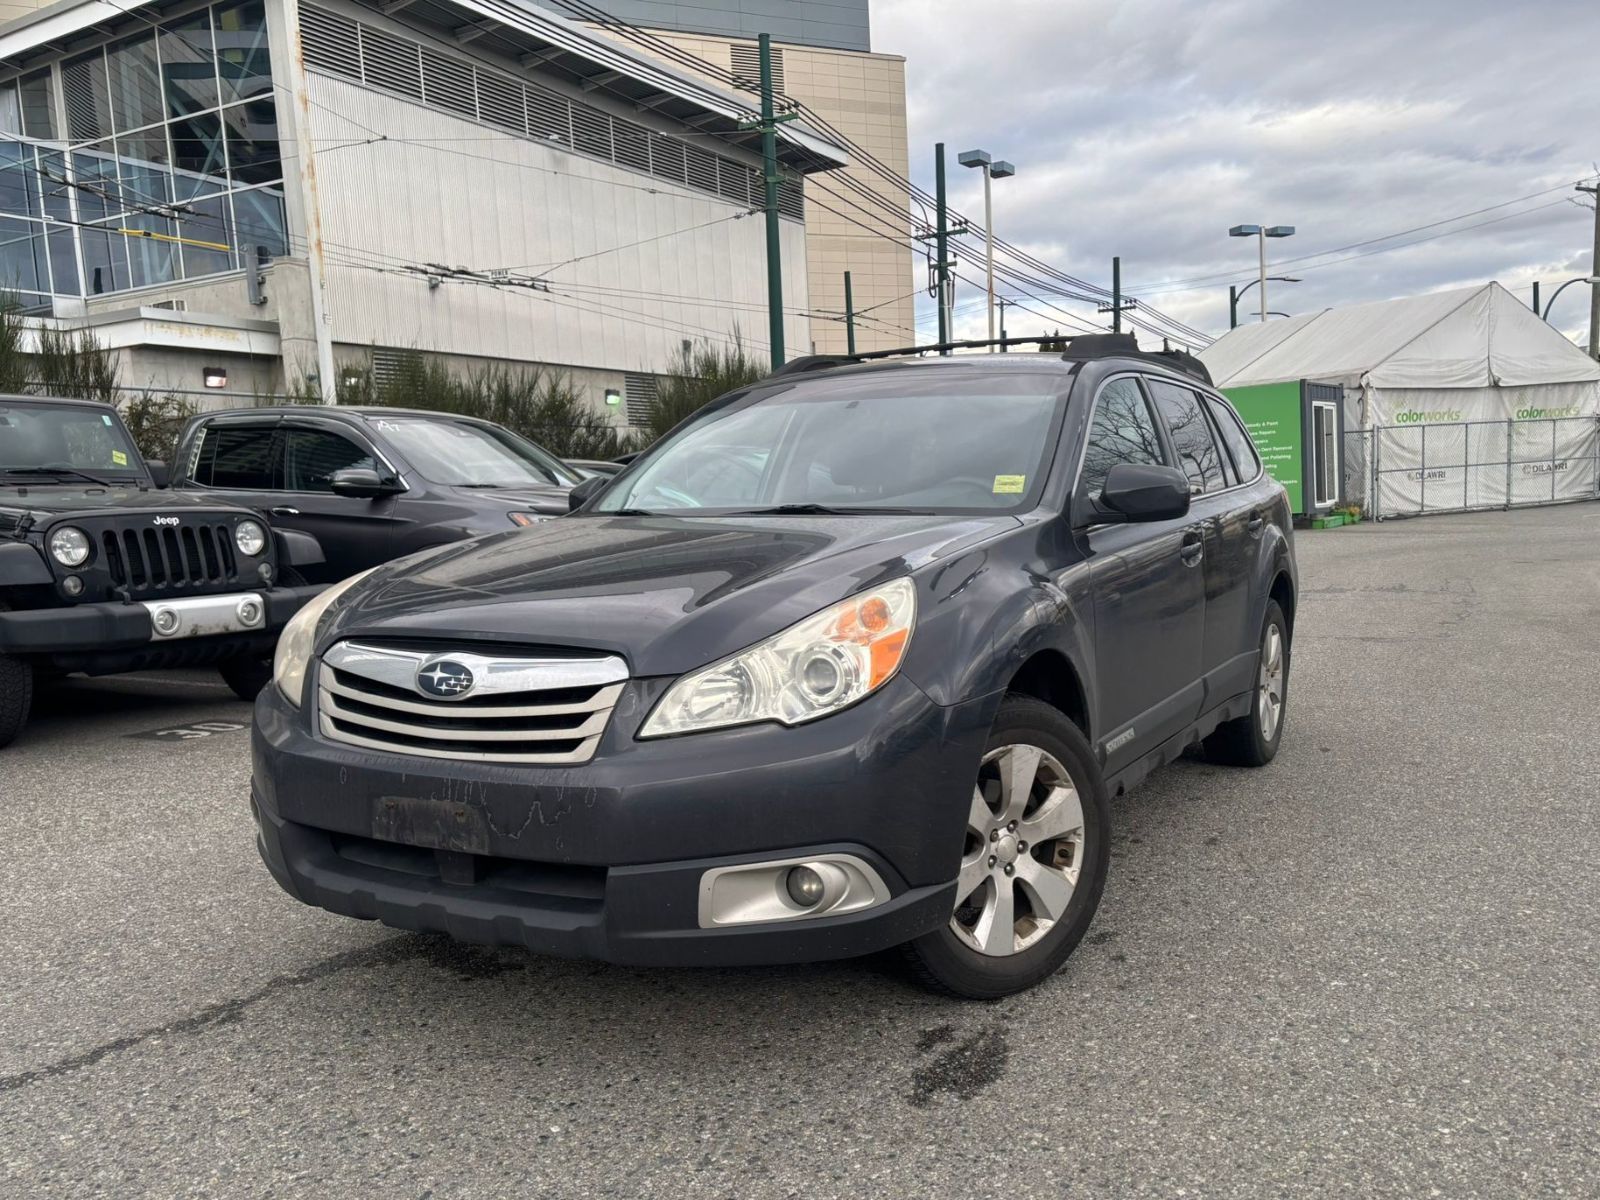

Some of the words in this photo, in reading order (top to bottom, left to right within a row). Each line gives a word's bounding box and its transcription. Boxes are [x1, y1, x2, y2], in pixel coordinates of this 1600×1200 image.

[1396, 408, 1461, 423] colorworks
[1516, 404, 1580, 419] colorworks
[153, 515, 180, 527] Jeep
